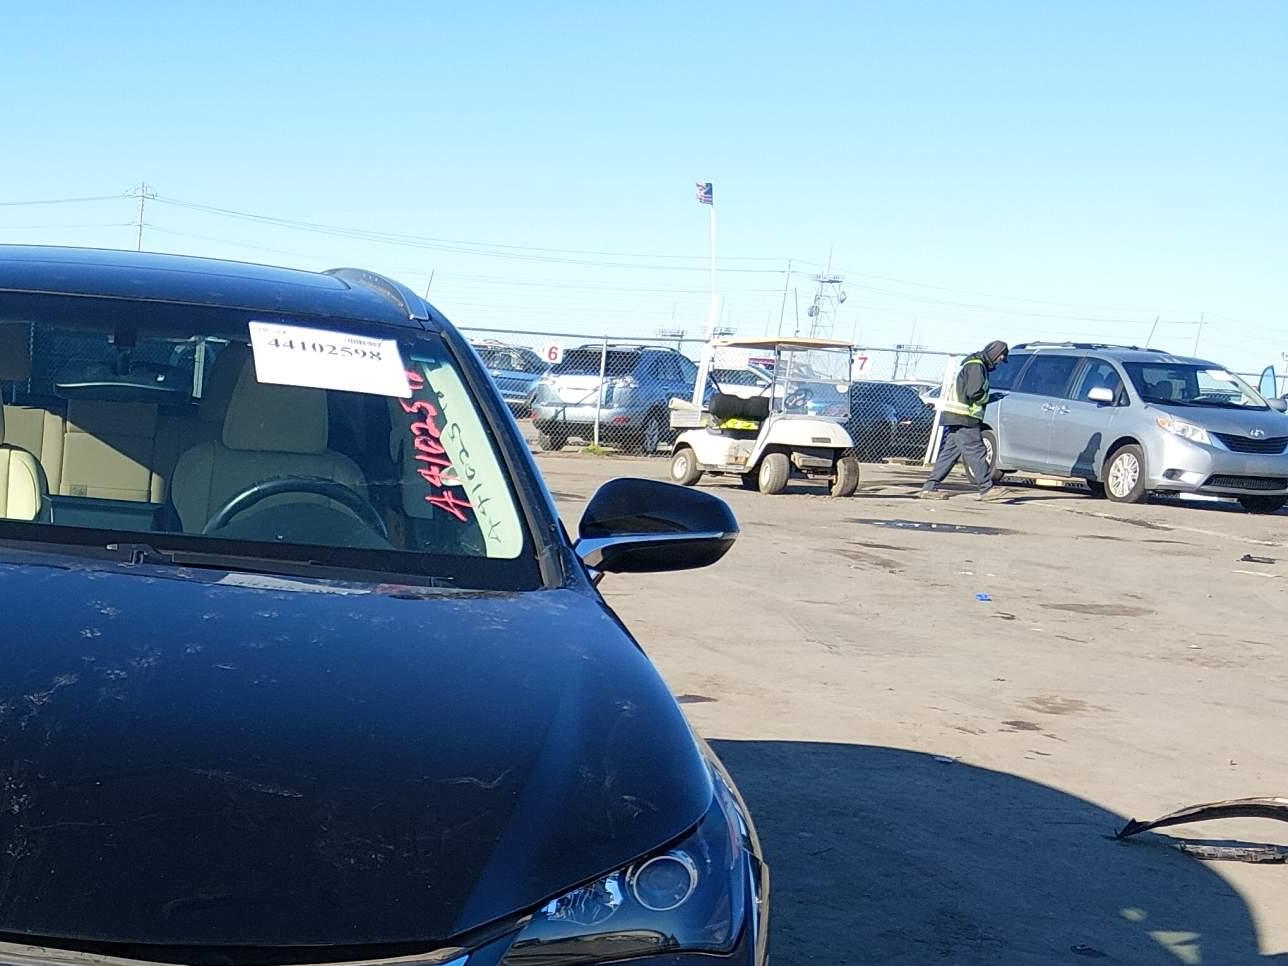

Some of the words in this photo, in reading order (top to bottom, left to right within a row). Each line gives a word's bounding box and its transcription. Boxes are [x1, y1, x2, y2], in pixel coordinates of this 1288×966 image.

[267, 338, 383, 361] 44102598
[548, 346, 558, 360] 6
[858, 357, 868, 370] 7
